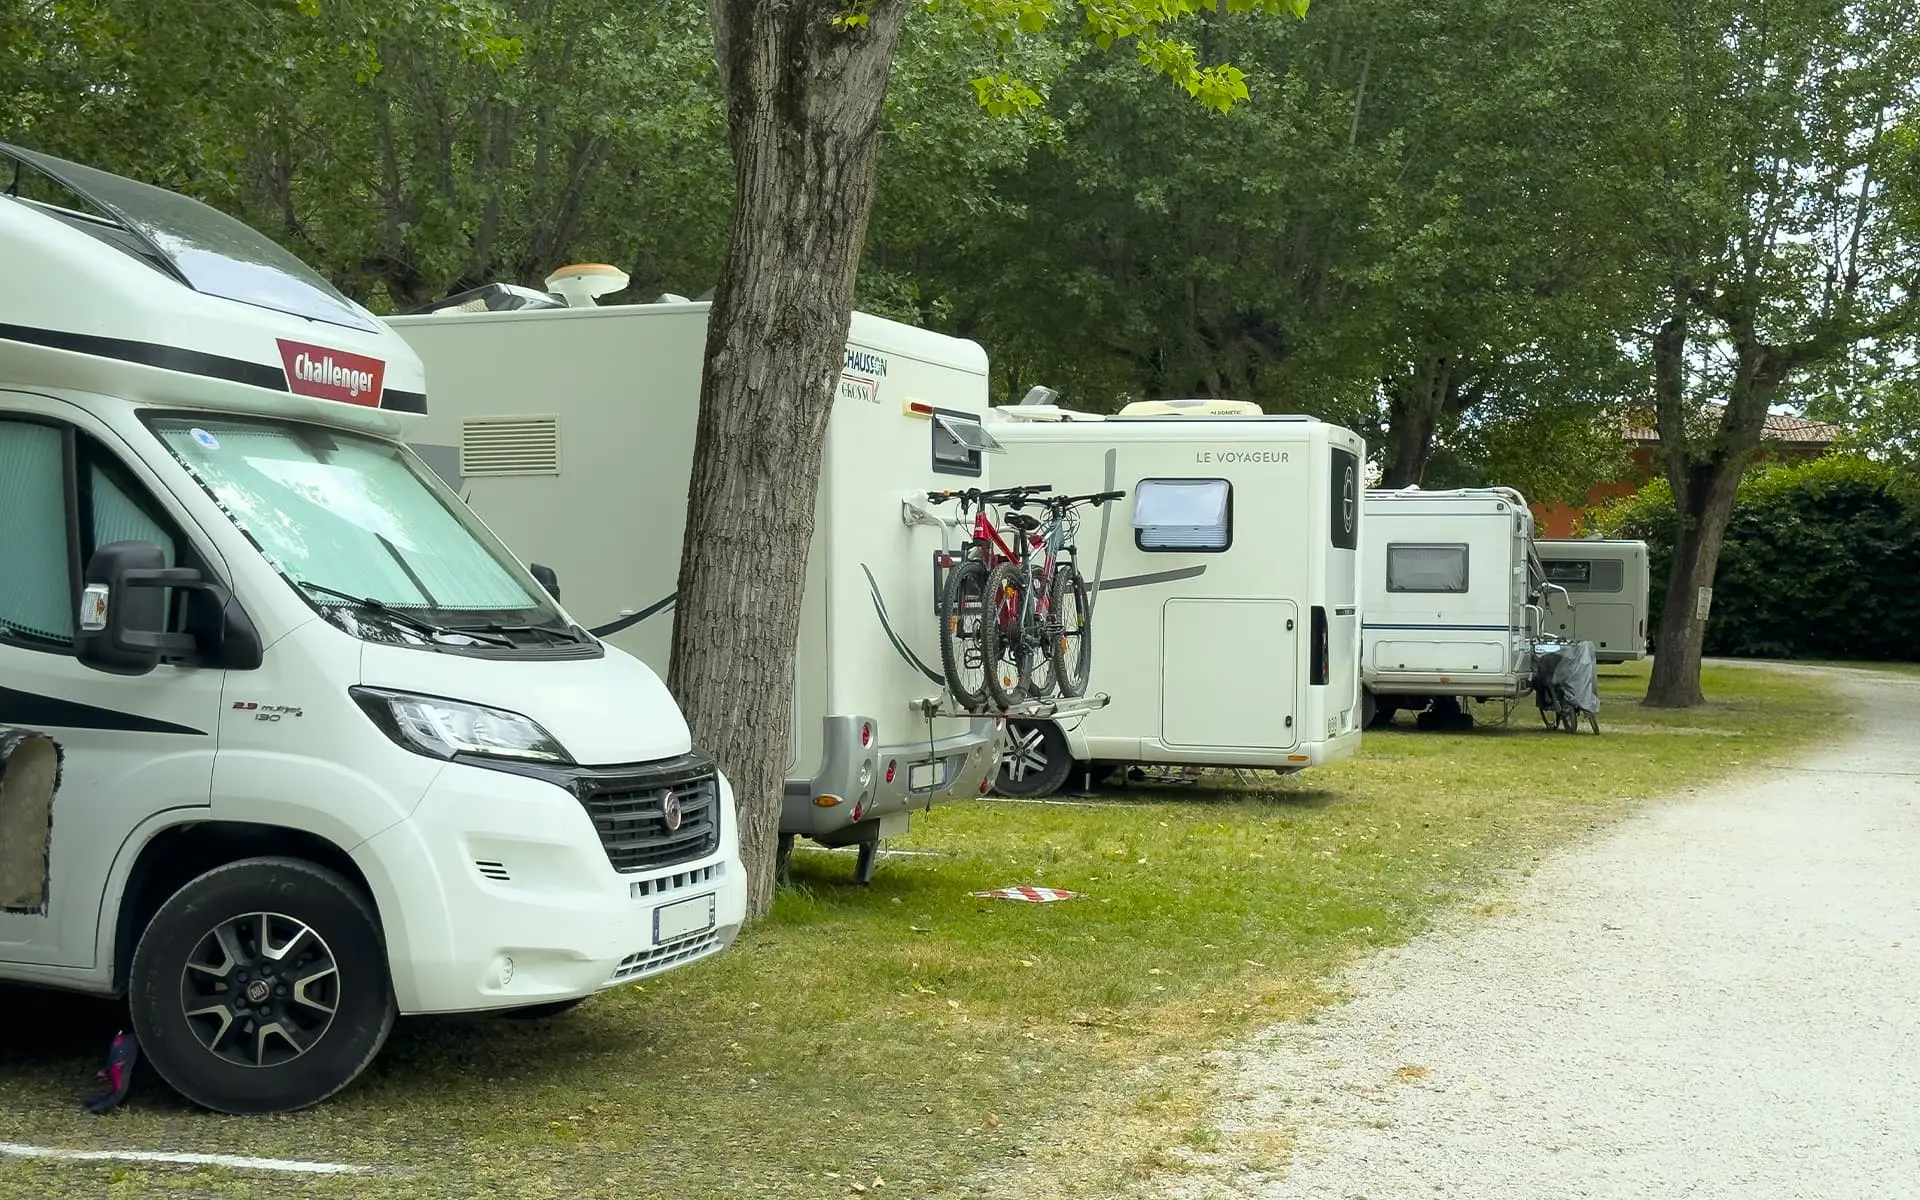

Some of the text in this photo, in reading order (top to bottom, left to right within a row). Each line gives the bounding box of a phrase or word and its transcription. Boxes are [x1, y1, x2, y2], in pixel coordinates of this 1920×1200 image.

[294, 351, 374, 397] Challenger
[1196, 452, 1289, 463] LE VOYAGEUR
[255, 713, 281, 721] 130
